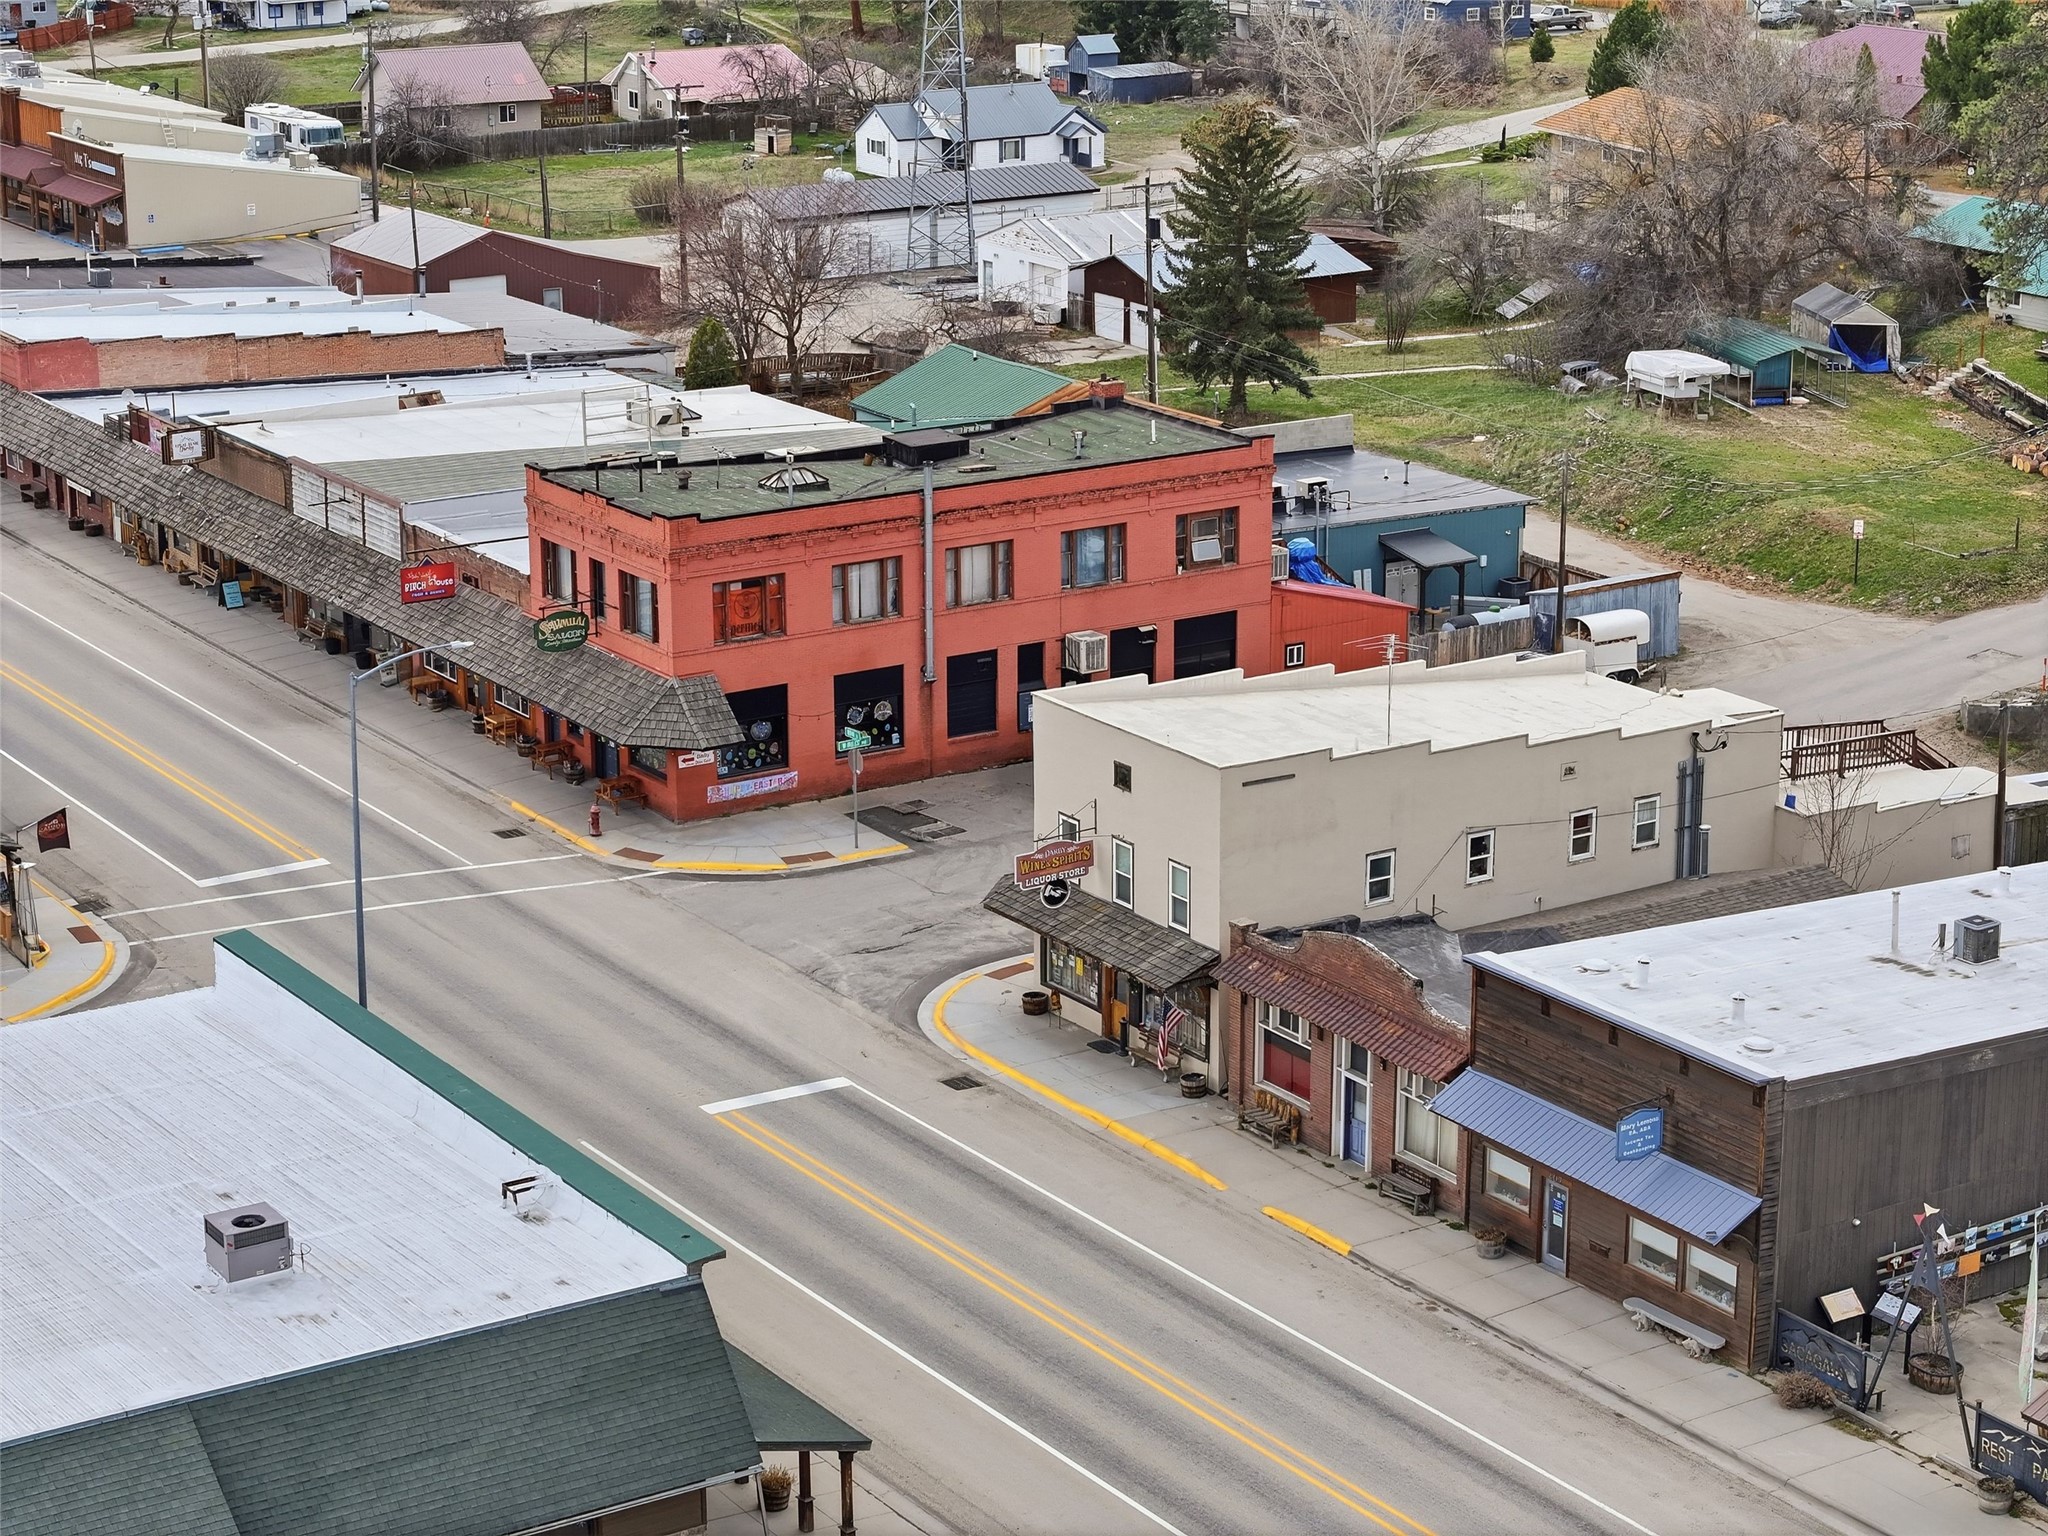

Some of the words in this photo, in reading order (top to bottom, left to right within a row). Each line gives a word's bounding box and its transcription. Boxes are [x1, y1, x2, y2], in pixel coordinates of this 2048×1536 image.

[404, 581, 427, 592] BIRCH
[547, 629, 586, 641] SALOON
[1020, 860, 1046, 875] WINE
[1052, 845, 1091, 868] SPIRITS
[1025, 873, 1058, 887] LIQUOR
[1058, 866, 1086, 879] STORE
[1981, 1436, 2015, 1466] REST
